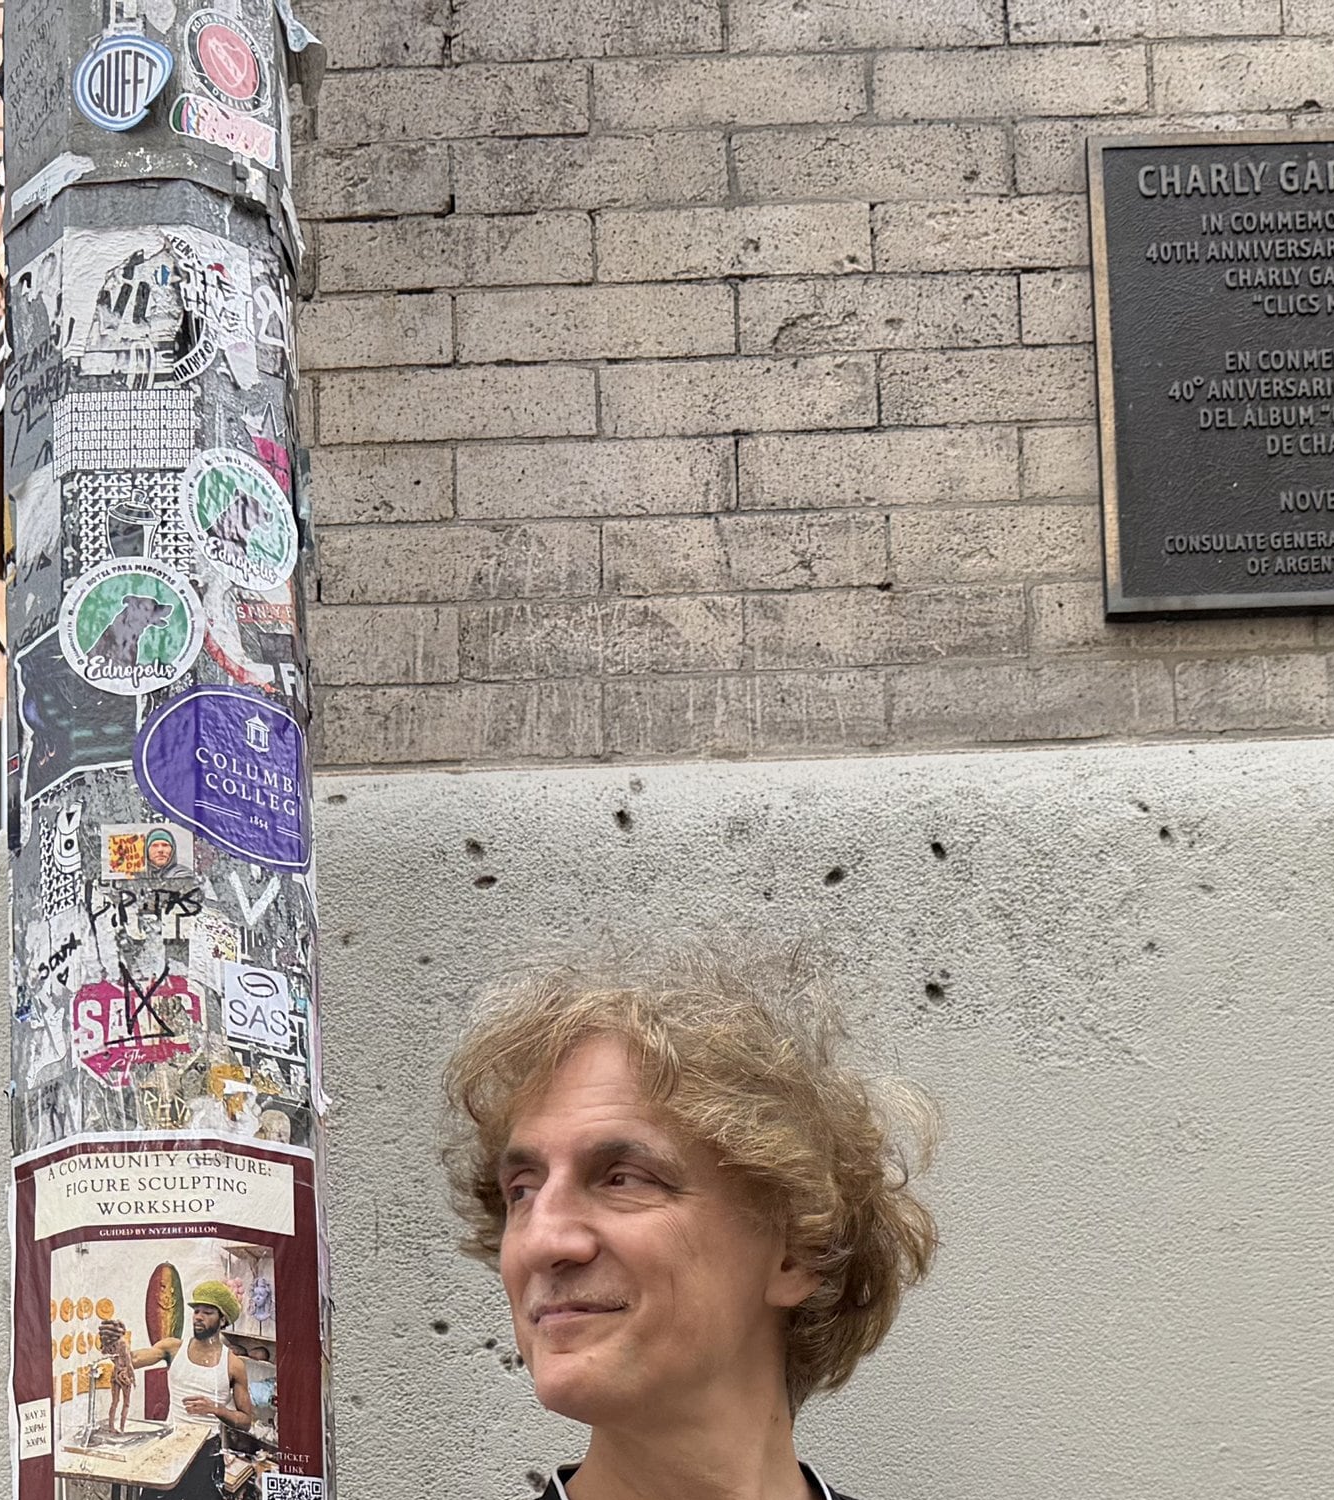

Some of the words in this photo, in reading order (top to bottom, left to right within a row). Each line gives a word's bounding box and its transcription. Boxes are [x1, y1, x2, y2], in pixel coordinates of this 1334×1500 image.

[1138, 161, 1267, 197] CHARLY
[1201, 212, 1224, 234] IN
[1145, 242, 1200, 264] 40TH
[1224, 266, 1303, 289] CHARLY
[1225, 351, 1251, 372] EN
[1199, 406, 1238, 430] DEL
[1266, 433, 1294, 456] DE
[1164, 532, 1266, 554] CONSULATE
[1247, 556, 1270, 575] OF
[86, 655, 176, 687] Ednopolis
[195, 746, 301, 797] COLUMBI
[205, 772, 296, 817] COLLEG
[229, 999, 288, 1037] SAS
[48, 1167, 56, 1181] A
[59, 1153, 178, 1176] COMMUNITY
[66, 1178, 131, 1197] FIGURE
[137, 1175, 248, 1195] SCULPTING
[97, 1198, 216, 1216] WORKSHOP
[99, 1227, 133, 1237] GUIDED
[135, 1227, 147, 1236] BY
[184, 1226, 217, 1235] DILLON
[276, 1451, 310, 1463] TICKET
[284, 1464, 305, 1475] LINK
